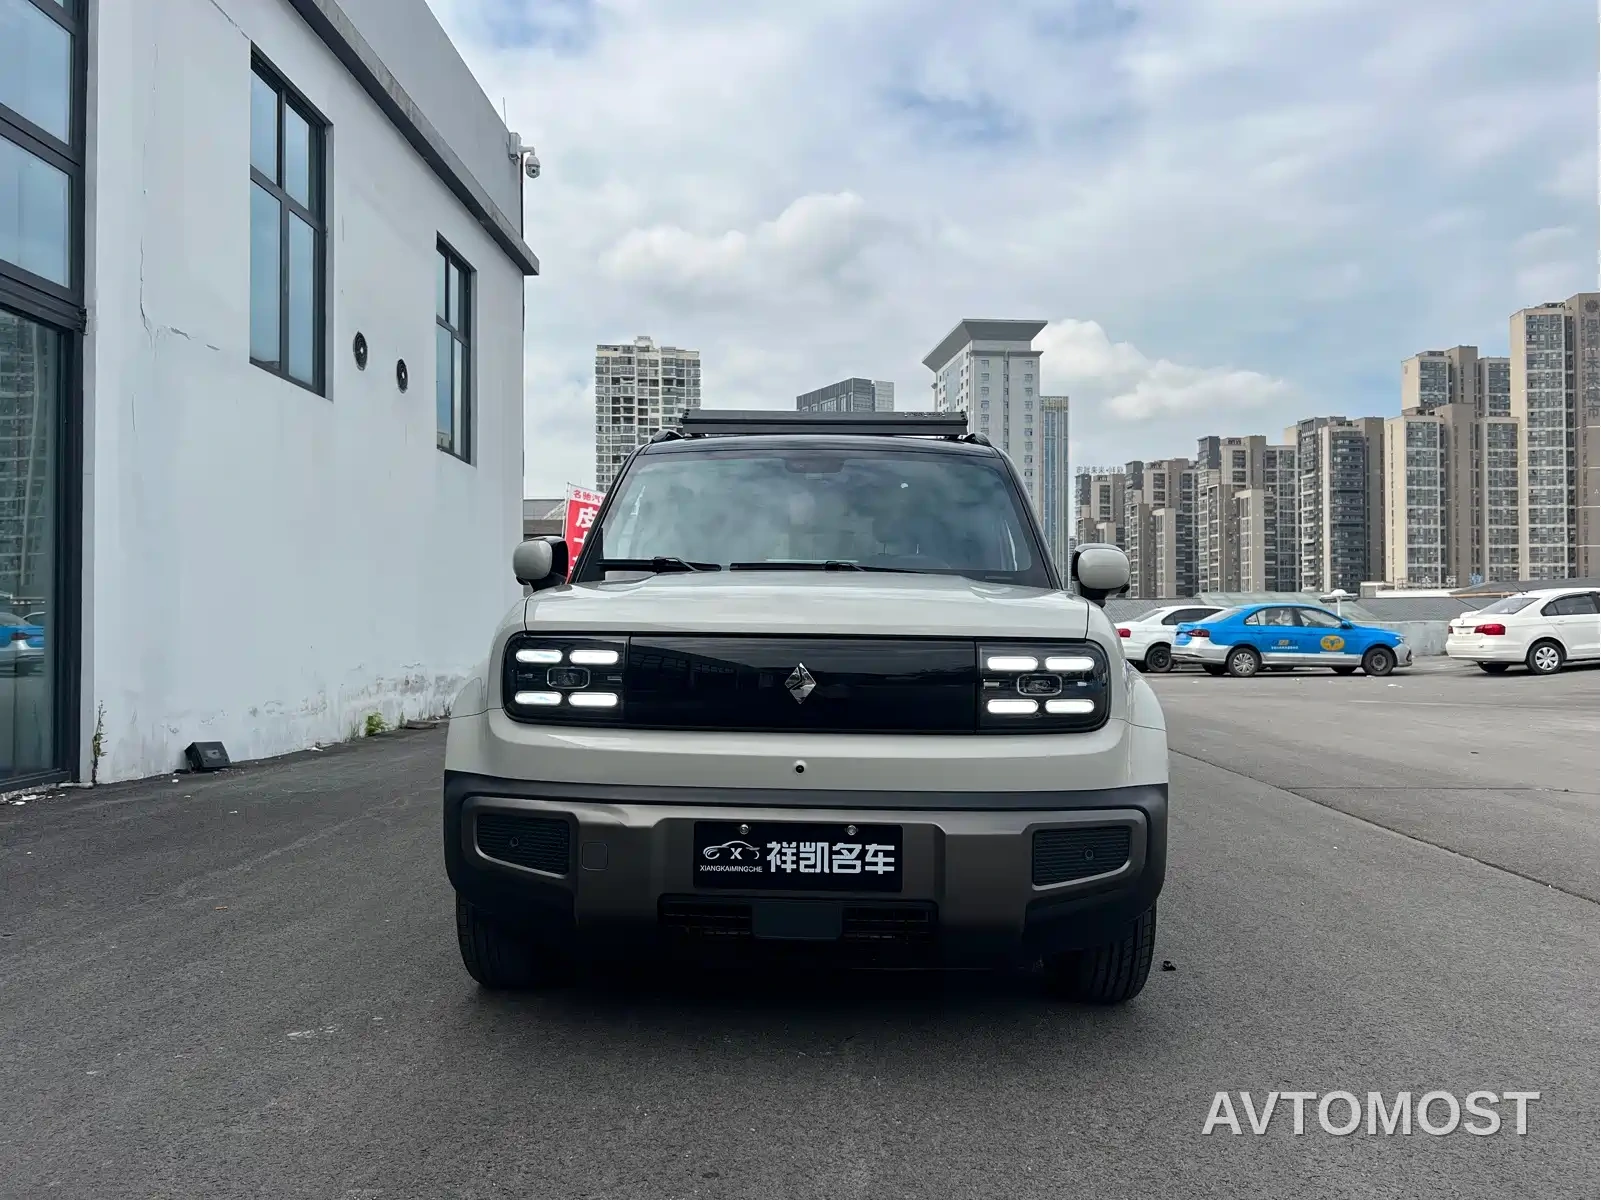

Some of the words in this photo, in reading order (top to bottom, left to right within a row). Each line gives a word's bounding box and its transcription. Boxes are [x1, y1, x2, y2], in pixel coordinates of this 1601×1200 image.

[573, 489, 605, 504] 名驰汽
[766, 841, 895, 874] 祥凯名车
[699, 864, 763, 873] XIANGKAIMINGCHE
